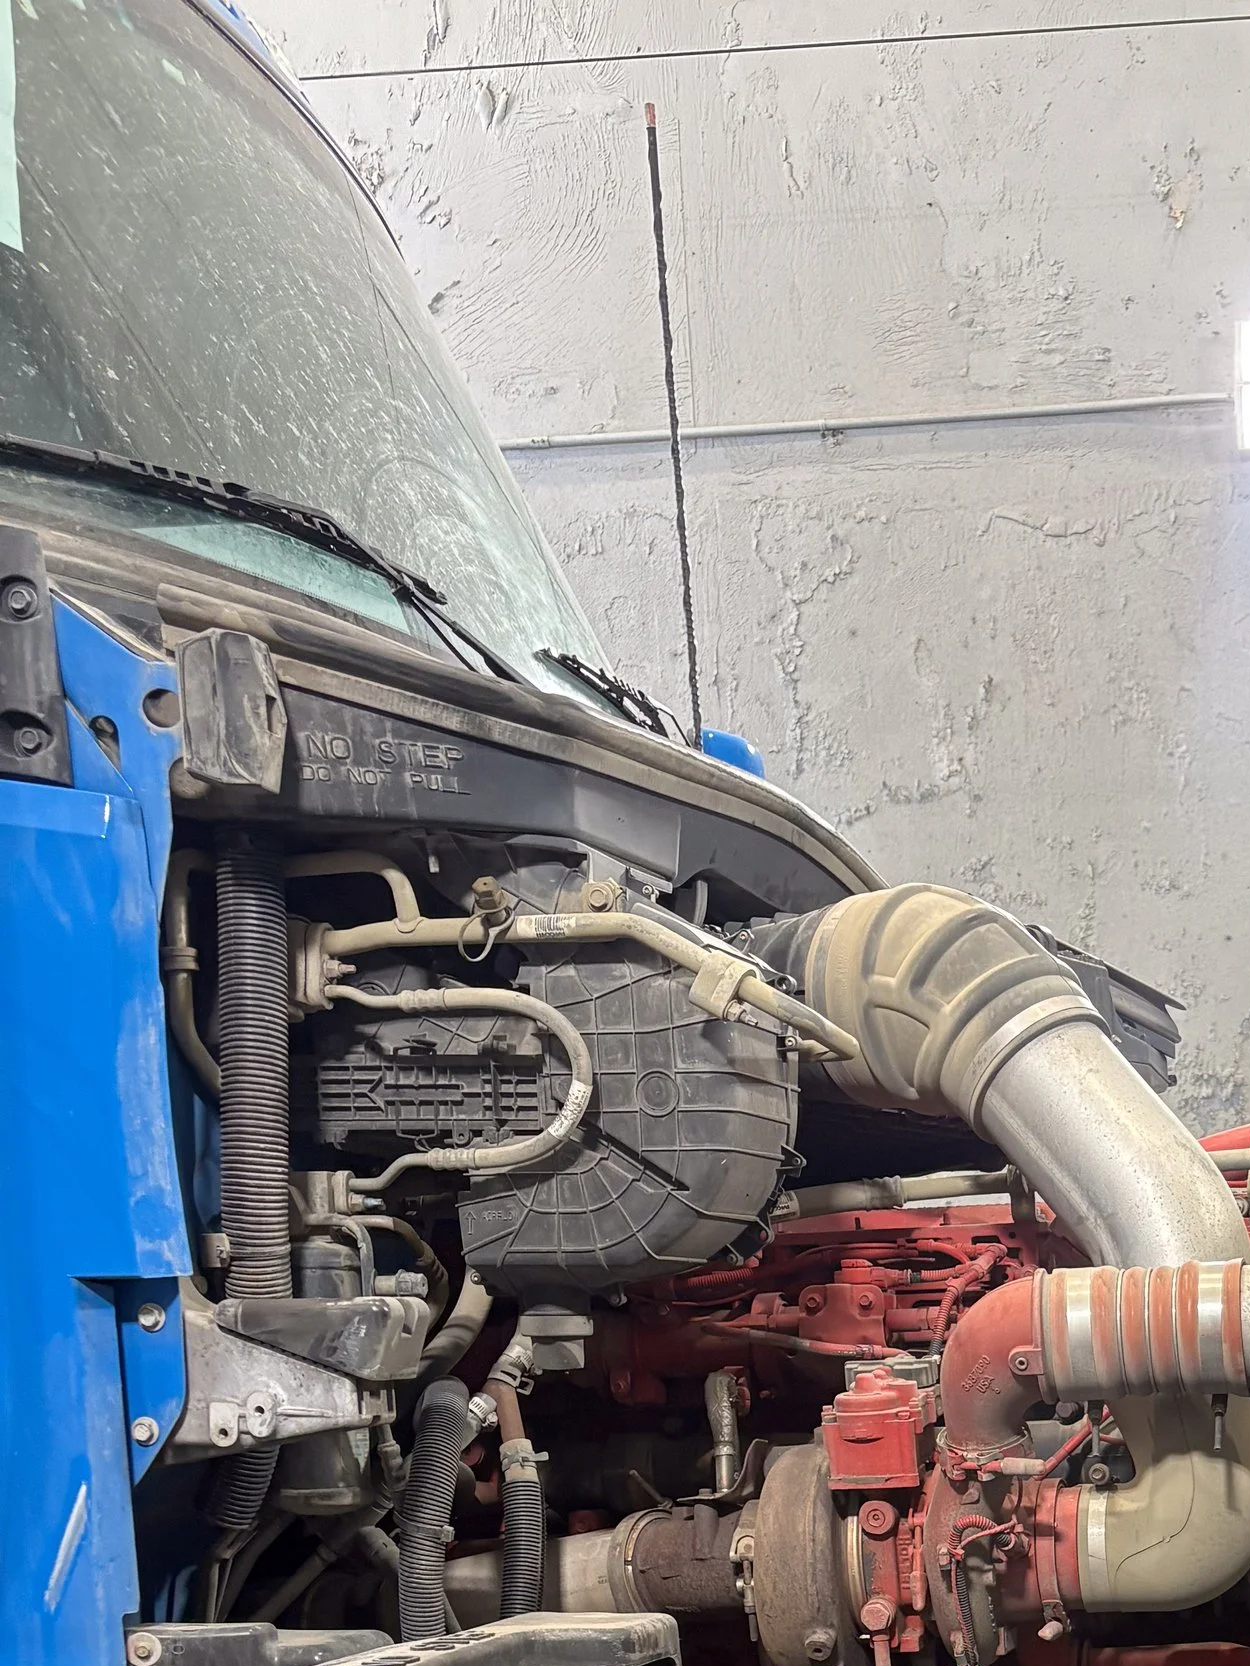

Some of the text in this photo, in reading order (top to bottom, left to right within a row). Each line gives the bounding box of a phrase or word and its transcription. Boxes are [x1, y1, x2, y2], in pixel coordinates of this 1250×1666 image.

[306, 732, 465, 770] NO STEP
[301, 764, 472, 795] DO NOT PULL
[975, 1374, 996, 1395] USA
